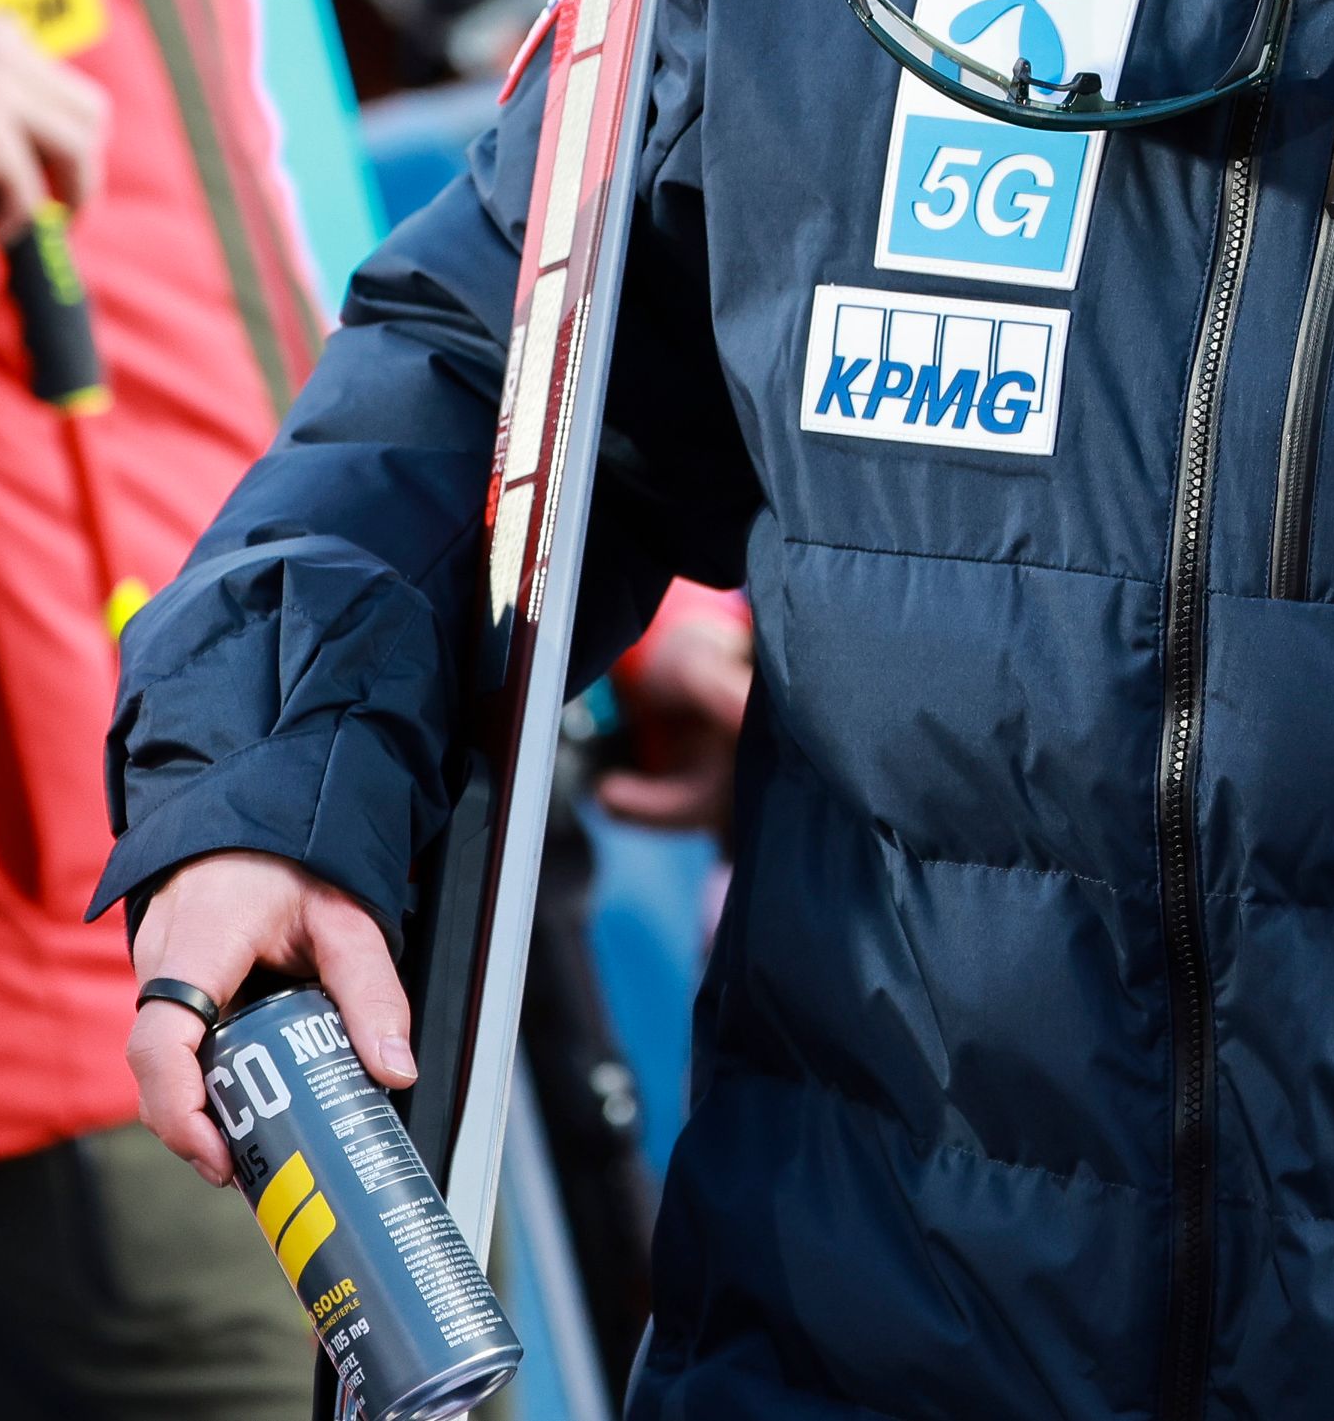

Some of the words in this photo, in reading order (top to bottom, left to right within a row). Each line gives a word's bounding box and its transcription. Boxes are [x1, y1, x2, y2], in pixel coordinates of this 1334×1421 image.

[910, 147, 1056, 240] 5G
[814, 354, 1038, 436] KPMG
[280, 1011, 351, 1066] NOC
[206, 1042, 293, 1141] CO
[313, 1278, 358, 1320] SOUR
[330, 1329, 351, 1354] 105
[348, 1317, 371, 1341] mg
